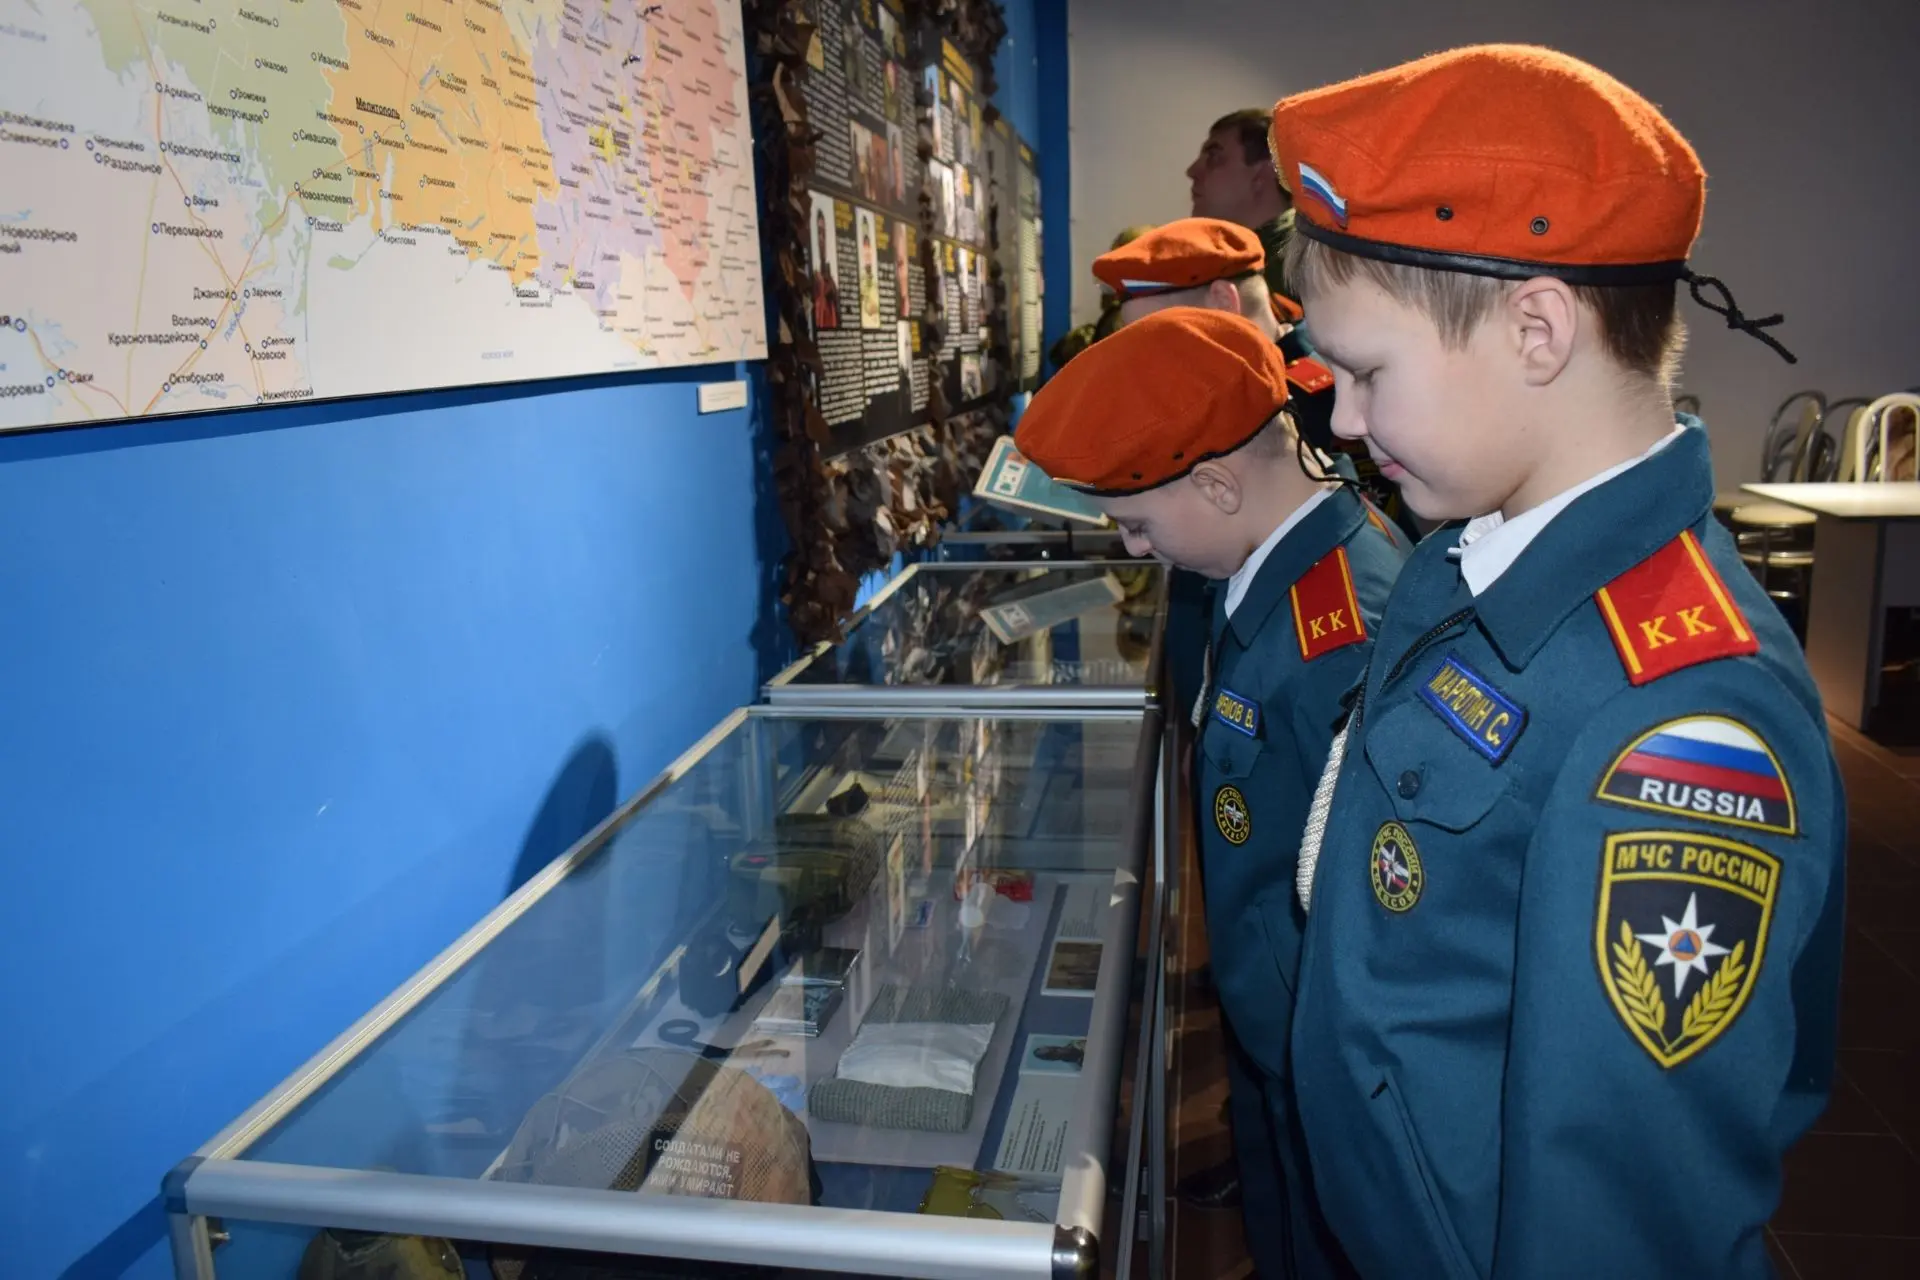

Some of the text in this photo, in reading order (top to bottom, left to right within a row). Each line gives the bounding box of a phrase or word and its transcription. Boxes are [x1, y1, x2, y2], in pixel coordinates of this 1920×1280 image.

[260, 58, 288, 74] Чкалово
[317, 52, 350, 71] Ивановка
[164, 84, 202, 101] Армянск
[235, 87, 267, 104] Громовка
[206, 102, 264, 124] Новотроицкое
[355, 96, 400, 120] Мелитополь
[299, 129, 338, 147] Сивашское
[167, 142, 242, 164] Красноперекопск
[103, 154, 163, 175] Раздольное
[317, 167, 342, 182] Рыково
[192, 194, 219, 207] Воинка
[160, 222, 224, 240] Первомайское
[383, 233, 417, 247] Кирилловка
[193, 286, 229, 301] Джанкой
[172, 314, 210, 328] Вольное
[108, 331, 200, 347] Красногвардейское
[252, 350, 287, 361] Азовское
[67, 370, 94, 384] Саки
[169, 369, 225, 388] Октябрьское
[262, 386, 315, 402] Нижнегорский
[1485, 711, 1510, 747] С.
[1639, 778, 1766, 823] RUSSIA
[1616, 845, 1772, 894] МЧС РОССИИ
[654, 1138, 741, 1164] СОЛДАТАМИ НЕ
[656, 1155, 733, 1180] РОЖДАЮТСЯ,
[680, 1176, 734, 1197] УМИРАЮТ
